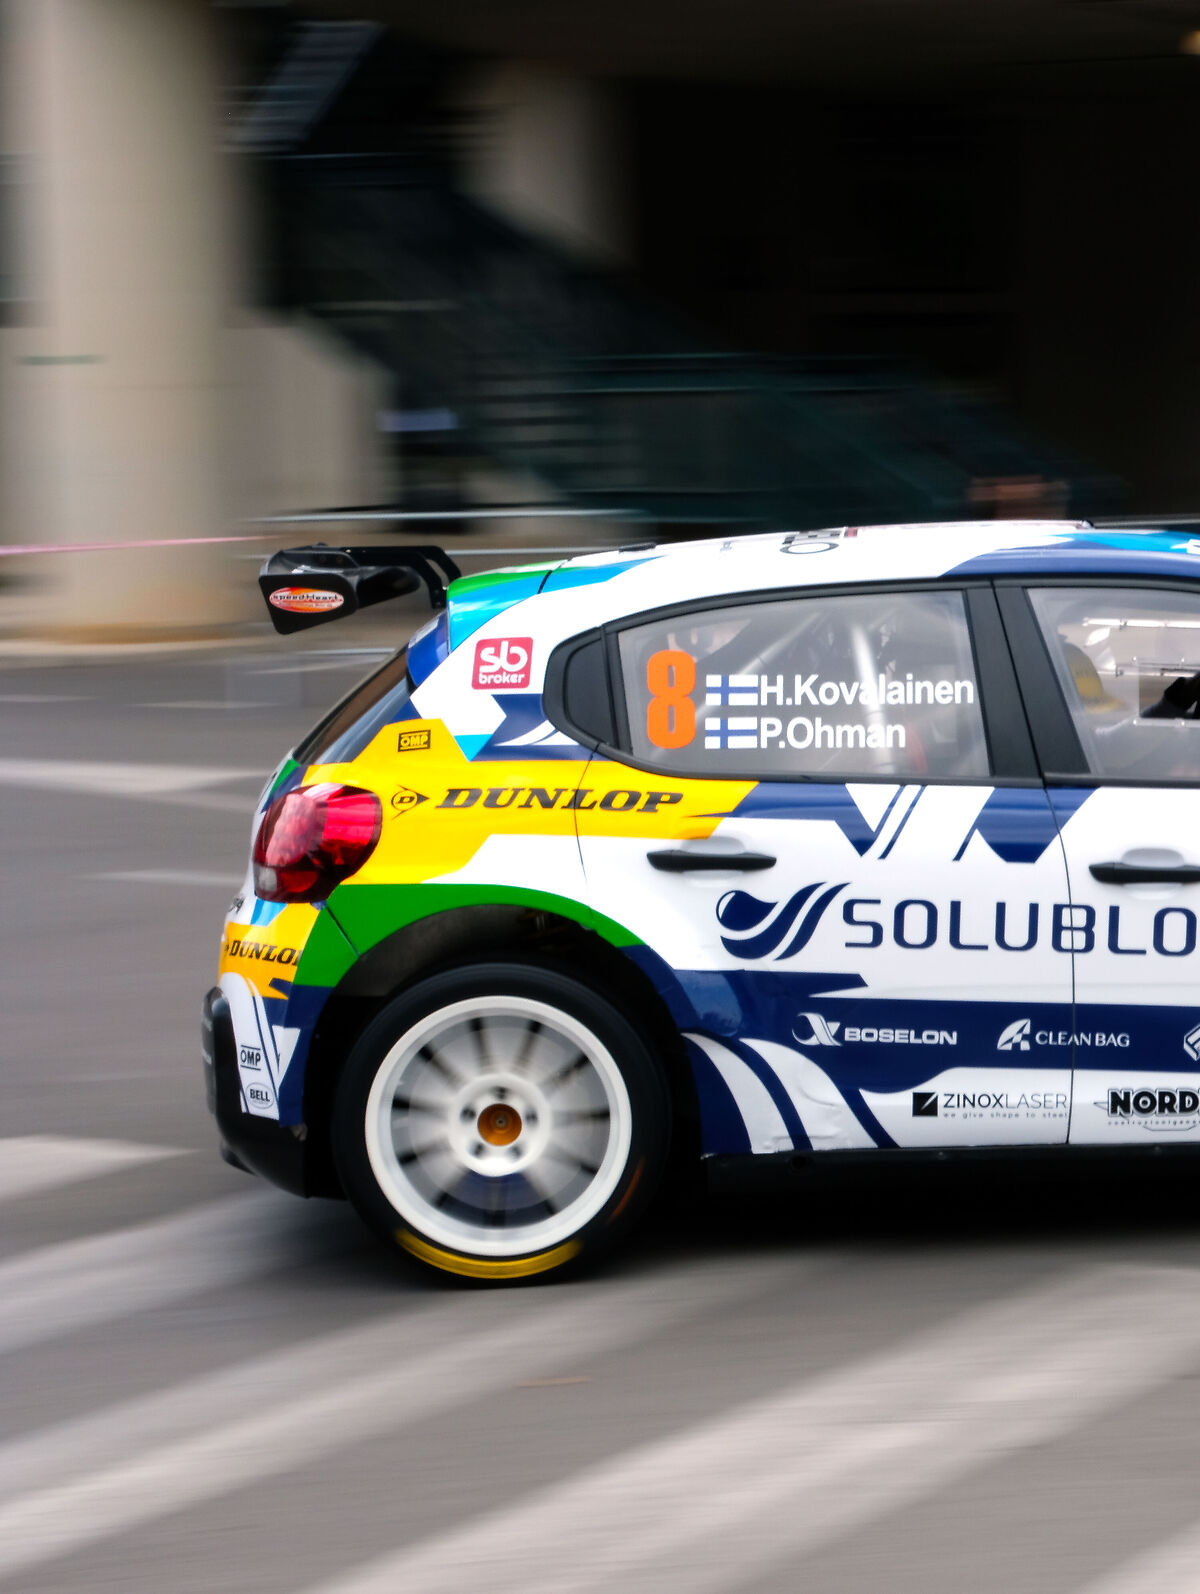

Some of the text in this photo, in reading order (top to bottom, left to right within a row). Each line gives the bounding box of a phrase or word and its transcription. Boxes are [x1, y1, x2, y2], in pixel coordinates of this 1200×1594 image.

[479, 639, 529, 673] sb
[478, 671, 525, 685] broker
[760, 673, 975, 706] H.Kovalainen
[646, 649, 697, 749] 8
[400, 733, 428, 748] OMP
[760, 716, 906, 749] P.Ohman
[434, 787, 684, 814] DUNLOP
[844, 1027, 958, 1046] BOSELON
[1035, 1031, 1131, 1048] CLEAN BAG
[240, 1049, 262, 1067] OMP
[249, 1088, 271, 1102] BELL
[943, 1092, 1068, 1110] ZINOXLASER
[962, 1112, 984, 1120] give
[989, 1111, 1020, 1119] shape
[1026, 1111, 1036, 1119] to
[1042, 1111, 1069, 1119] steel
